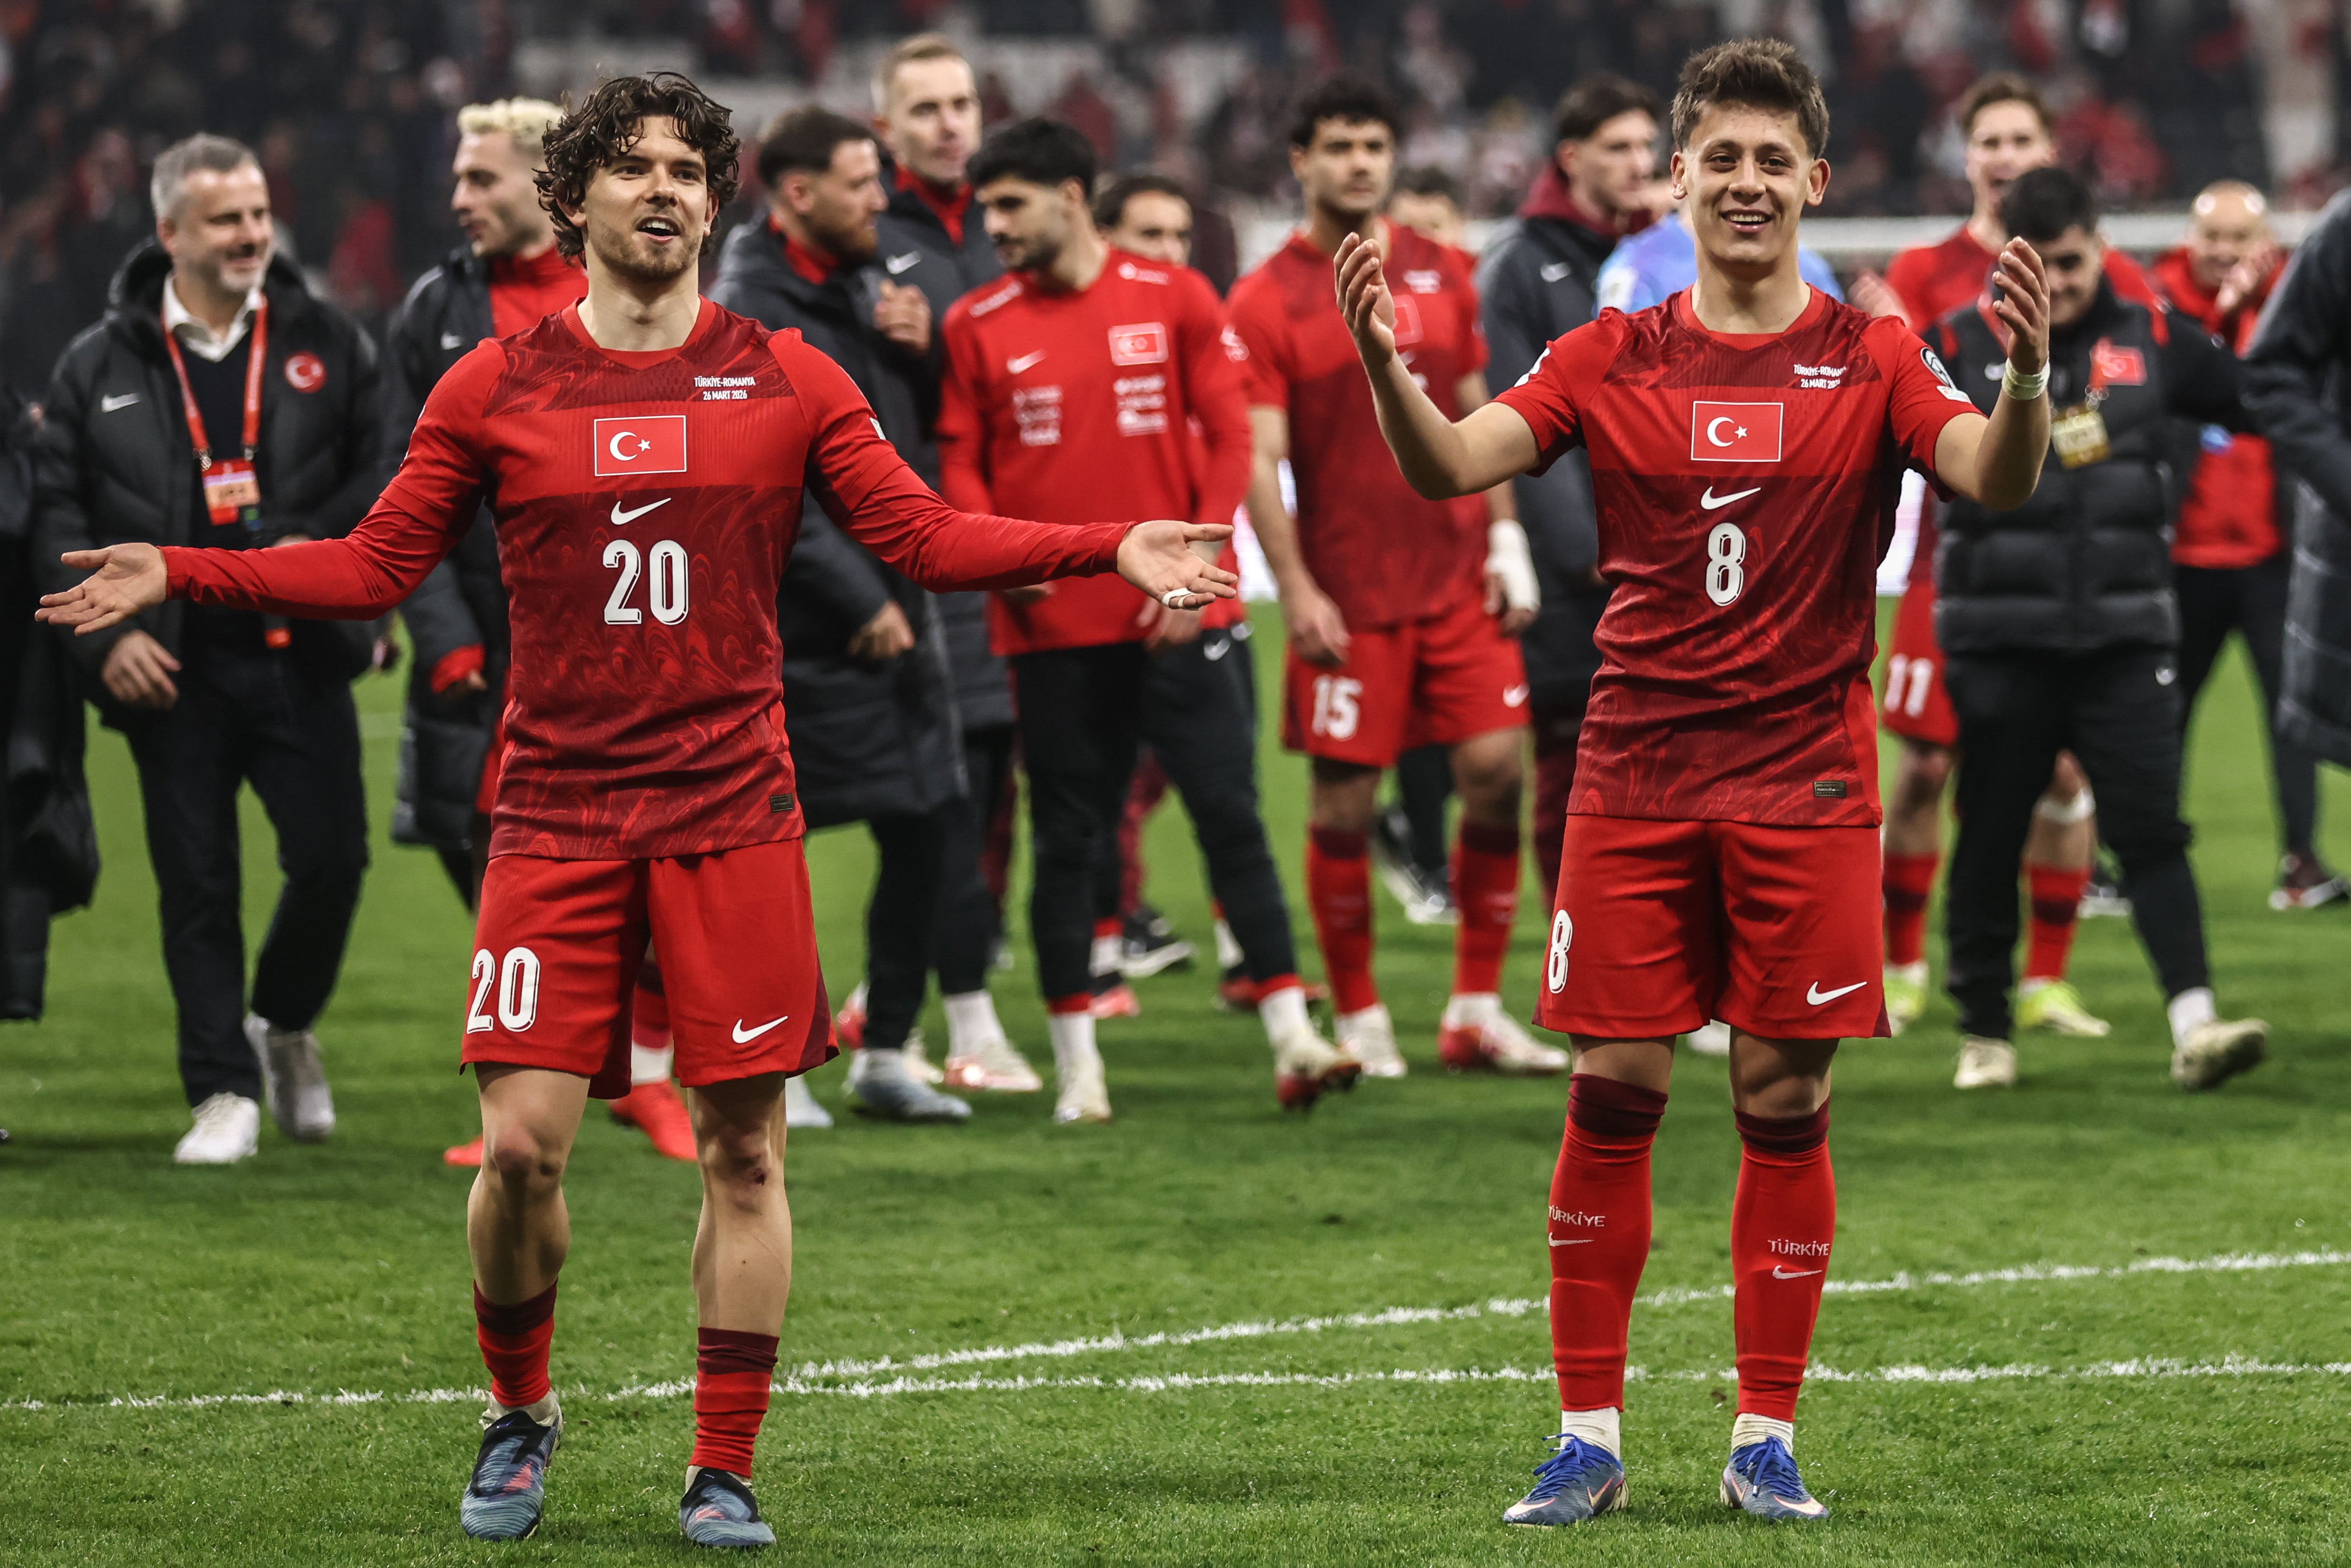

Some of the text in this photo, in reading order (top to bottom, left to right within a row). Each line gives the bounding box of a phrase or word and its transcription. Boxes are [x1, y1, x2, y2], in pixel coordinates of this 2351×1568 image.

[694, 376, 755, 387] TÜRKİYE-ROMANYA
[703, 390, 748, 400] 26 MART 2026
[1800, 378, 1809, 388] 26
[1809, 378, 1827, 388] MART
[603, 539, 689, 625] 20
[1705, 523, 1746, 606] 8
[1312, 674, 1363, 741] 15
[1884, 653, 1934, 718] 11
[1548, 909, 1573, 994] 8
[466, 947, 540, 1035] 20
[1548, 1205, 1606, 1227] TÜRKİYE
[1767, 1239, 1830, 1256] TÜRKİYE
